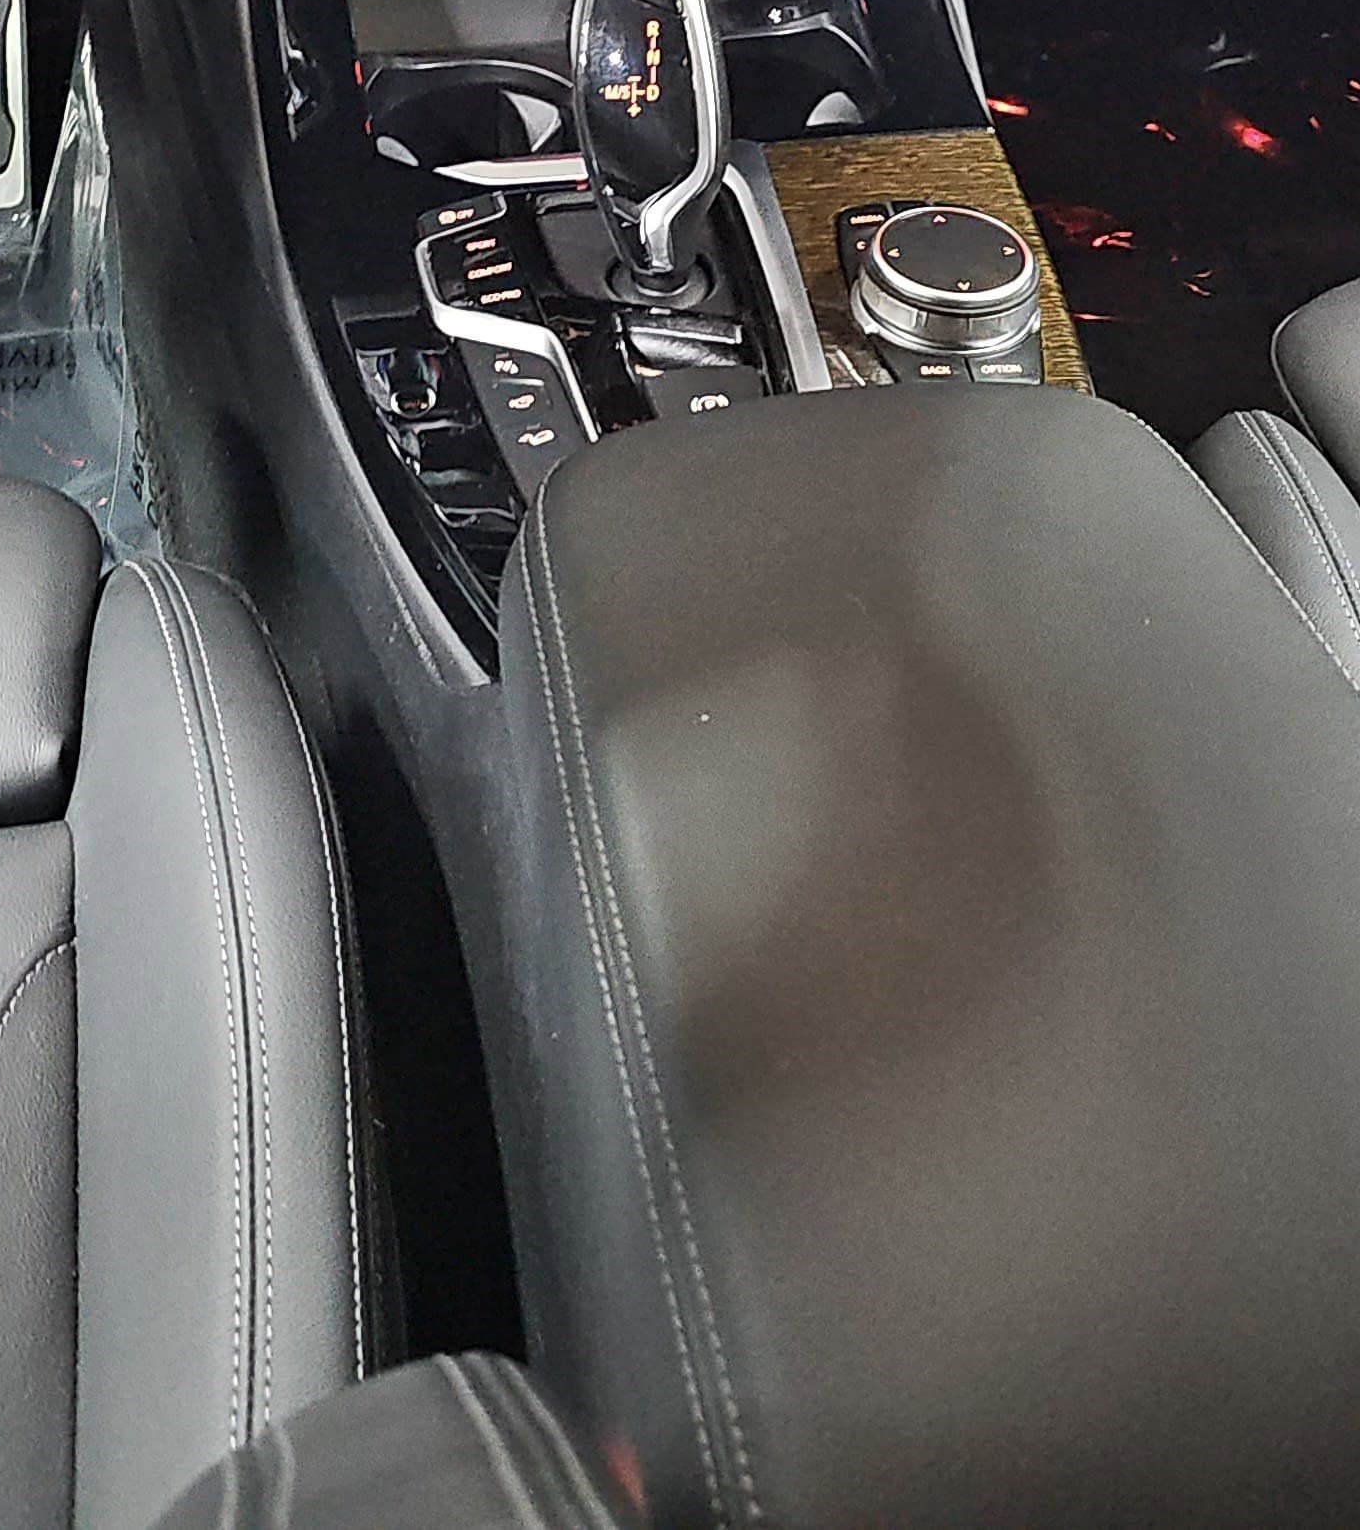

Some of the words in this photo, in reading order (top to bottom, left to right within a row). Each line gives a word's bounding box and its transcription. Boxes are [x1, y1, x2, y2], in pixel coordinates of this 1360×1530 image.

[646, 20, 660, 38] R
[646, 49, 661, 67] N
[646, 84, 660, 101] D
[920, 365, 952, 376] BACK
[980, 364, 1023, 375] OPTION
